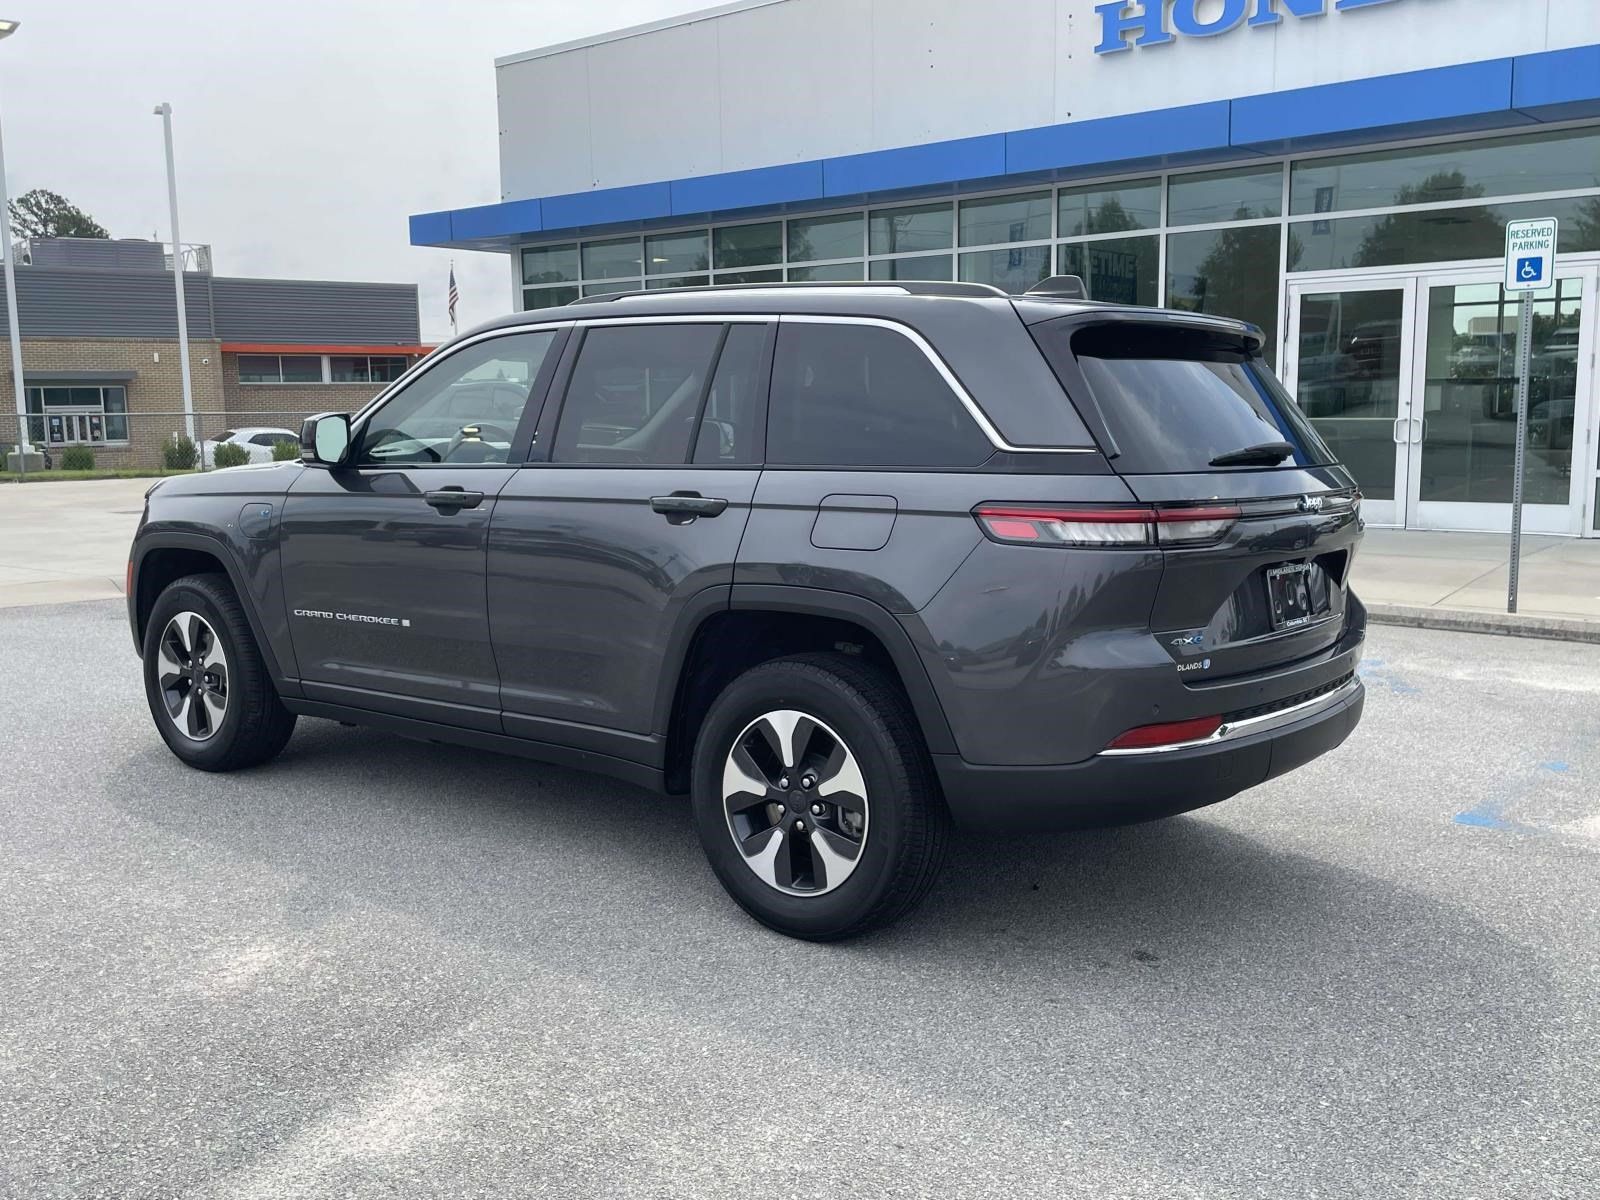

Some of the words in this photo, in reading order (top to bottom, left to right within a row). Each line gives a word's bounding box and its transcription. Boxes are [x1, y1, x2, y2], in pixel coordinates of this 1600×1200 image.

[1094, 0, 1398, 54] HO
[1510, 227, 1553, 239] RESERVED
[1512, 239, 1549, 251] PARKING
[294, 609, 333, 619] GRAND
[336, 613, 399, 625] CHEROKEE
